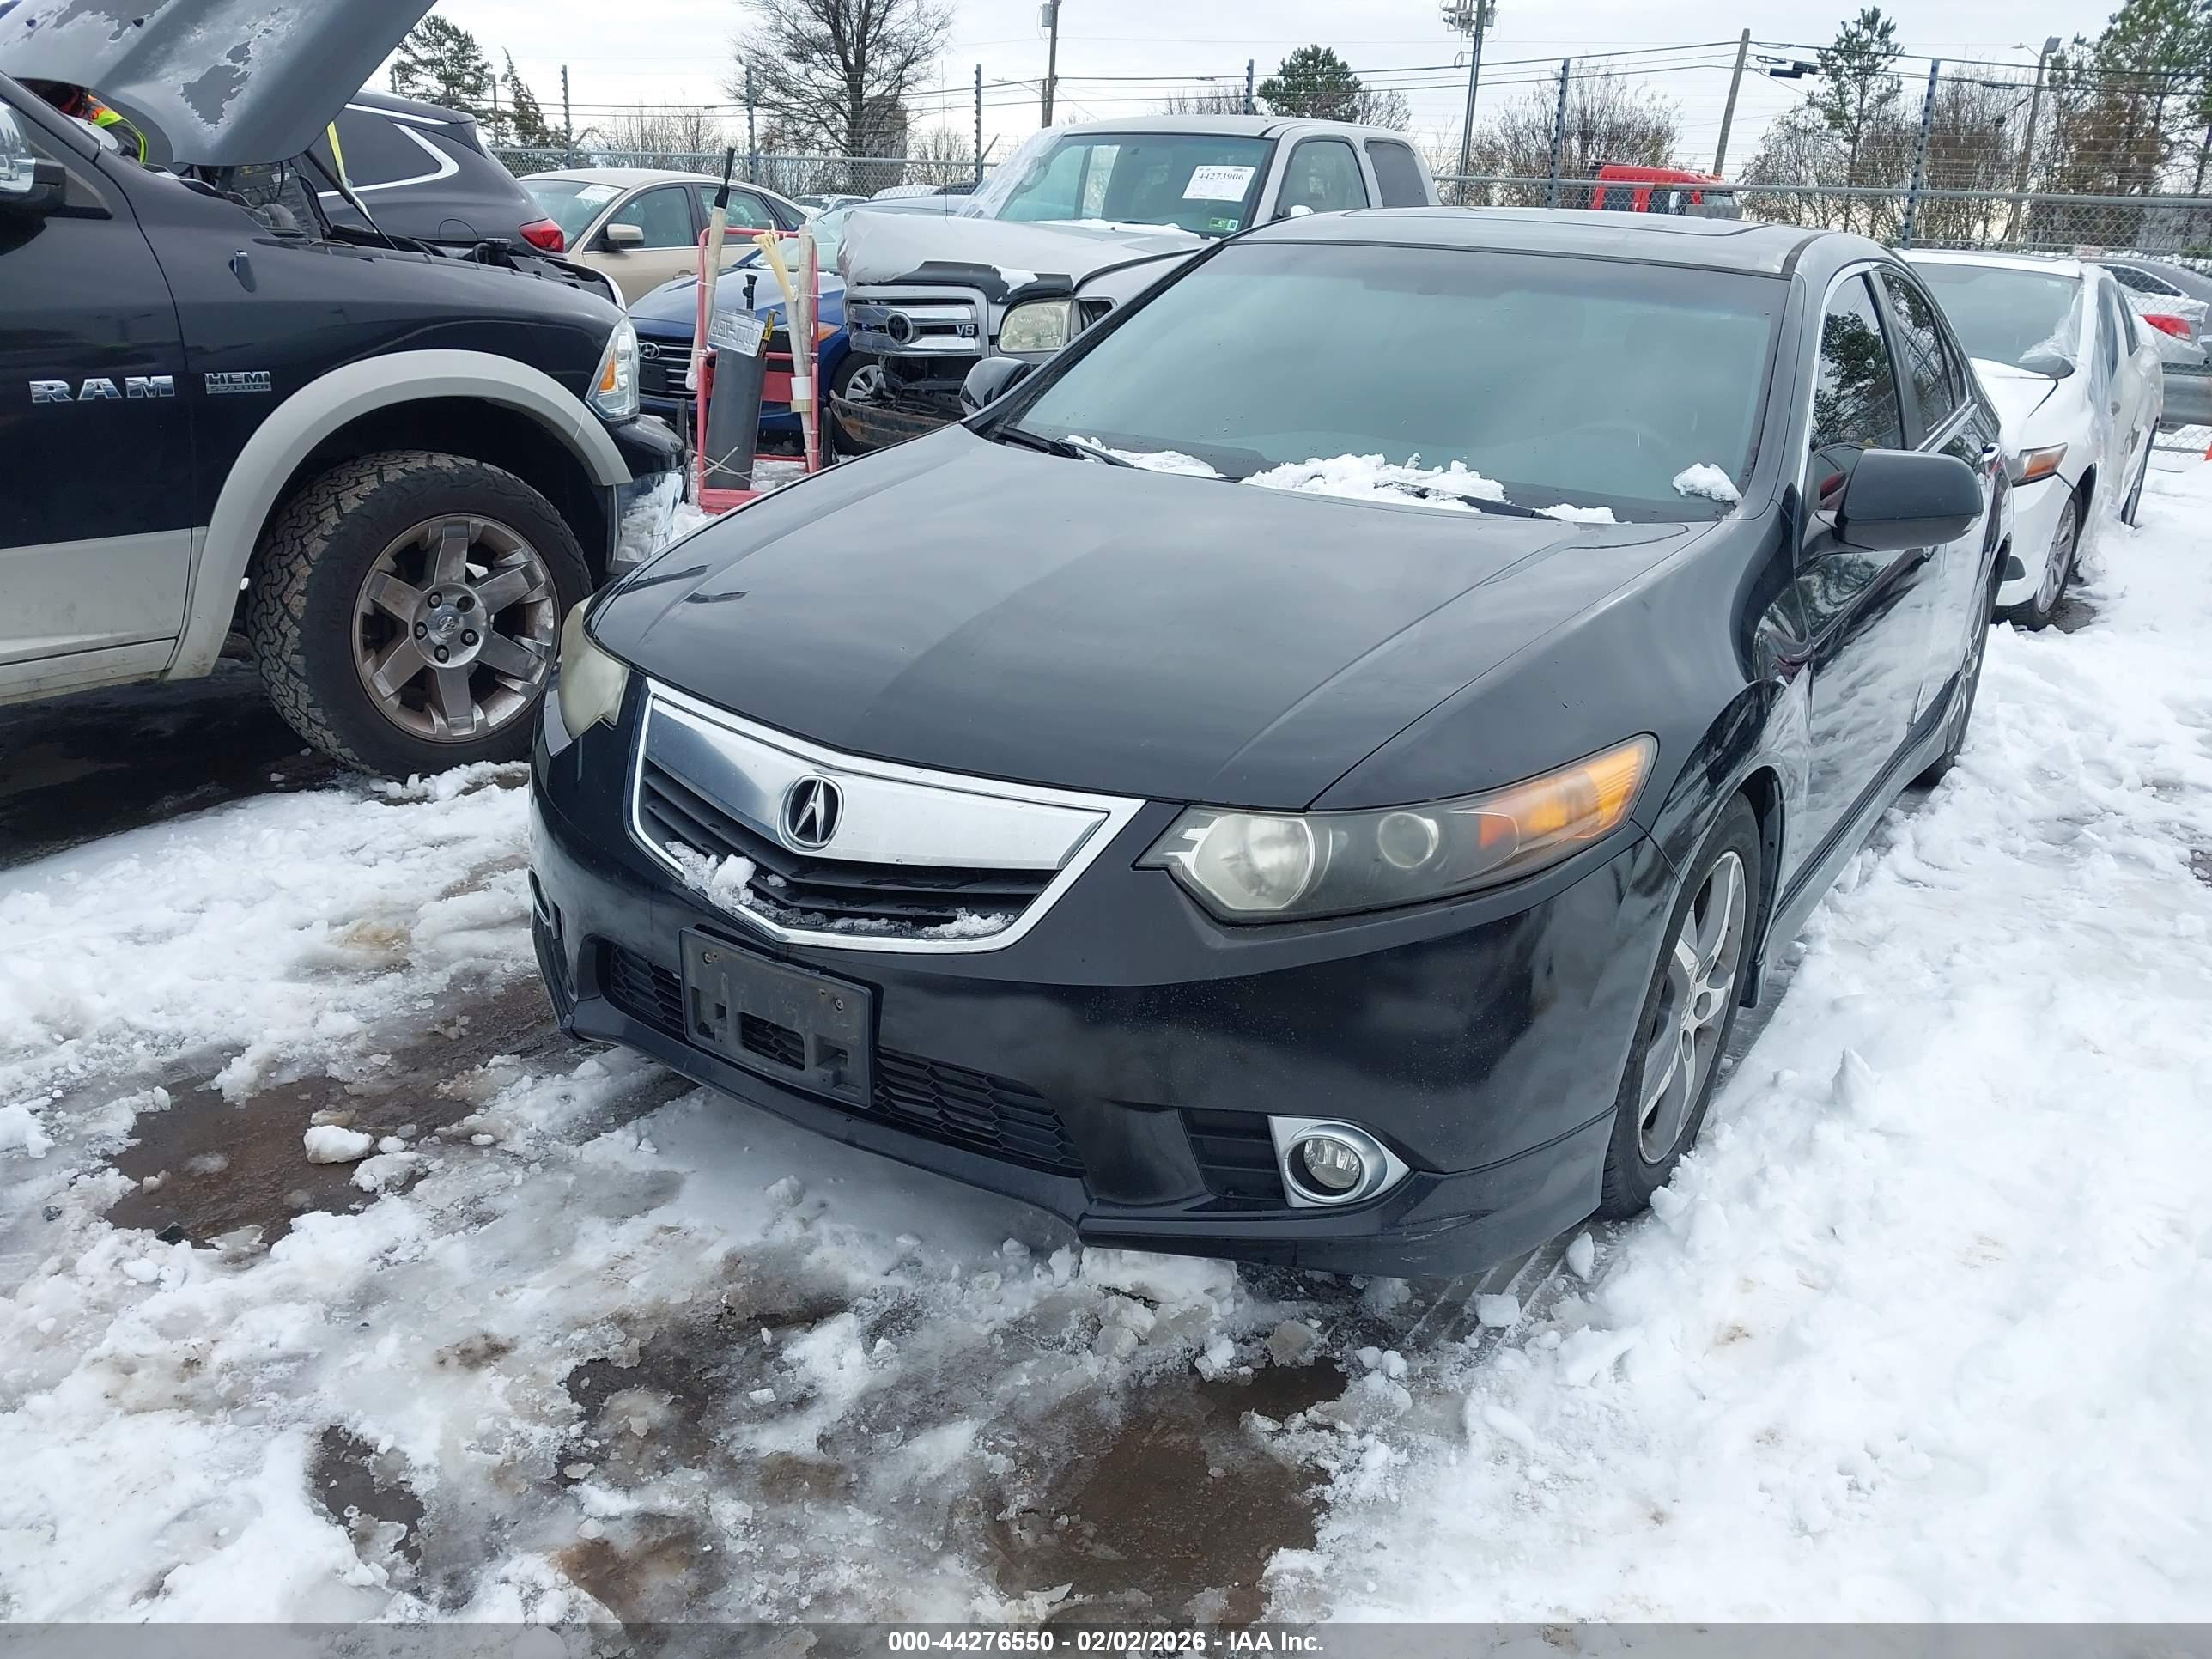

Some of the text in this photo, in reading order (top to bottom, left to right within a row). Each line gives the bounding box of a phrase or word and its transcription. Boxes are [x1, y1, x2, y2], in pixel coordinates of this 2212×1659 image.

[955, 324, 975, 336] V8
[206, 371, 270, 385] HEMI
[28, 375, 175, 403] RAM
